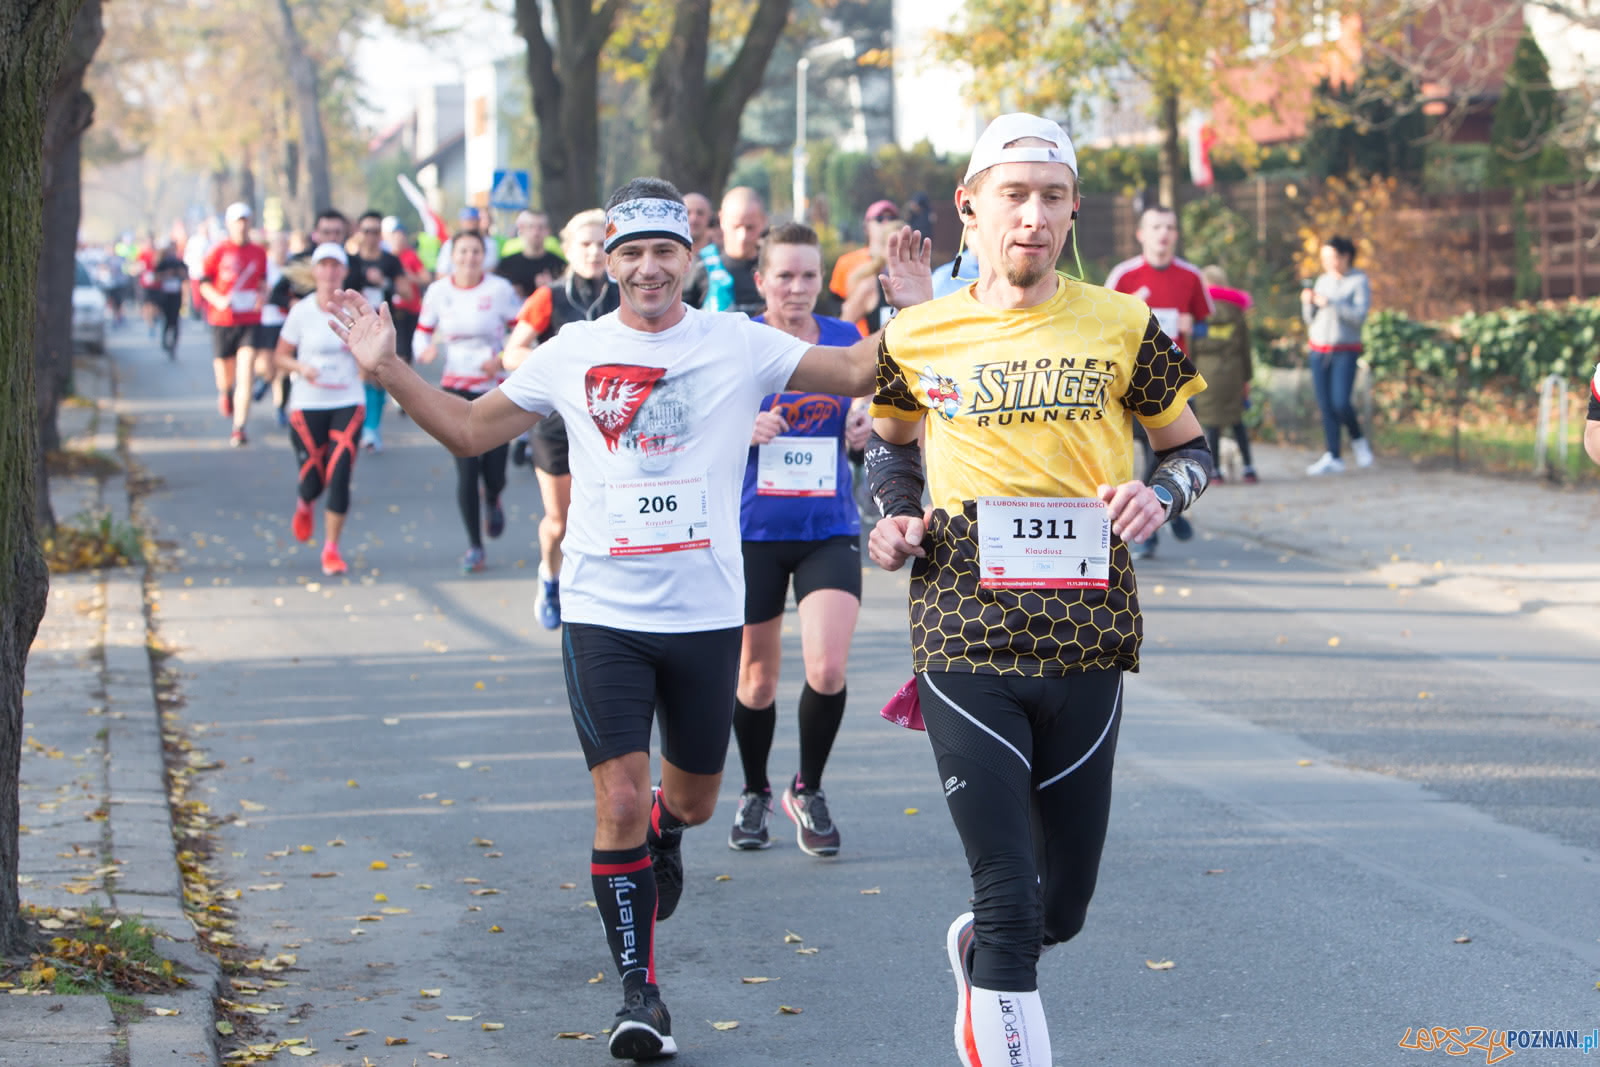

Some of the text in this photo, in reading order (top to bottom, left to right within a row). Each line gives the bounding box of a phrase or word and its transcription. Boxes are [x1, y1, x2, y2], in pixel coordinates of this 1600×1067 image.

[1011, 357, 1117, 372] HONEY
[969, 361, 1115, 414] STINGER
[977, 408, 1104, 427] RUNNERS
[784, 451, 813, 465] 609
[638, 495, 678, 514] 206
[992, 499, 1029, 507] LUBOŃSKI
[1029, 500, 1046, 508] BIEG
[1047, 500, 1105, 509] NIEPODLEGŁOŚCI
[1012, 519, 1077, 539] 1311
[1025, 547, 1062, 555] Klaudiusz
[609, 876, 637, 966] kalenji
